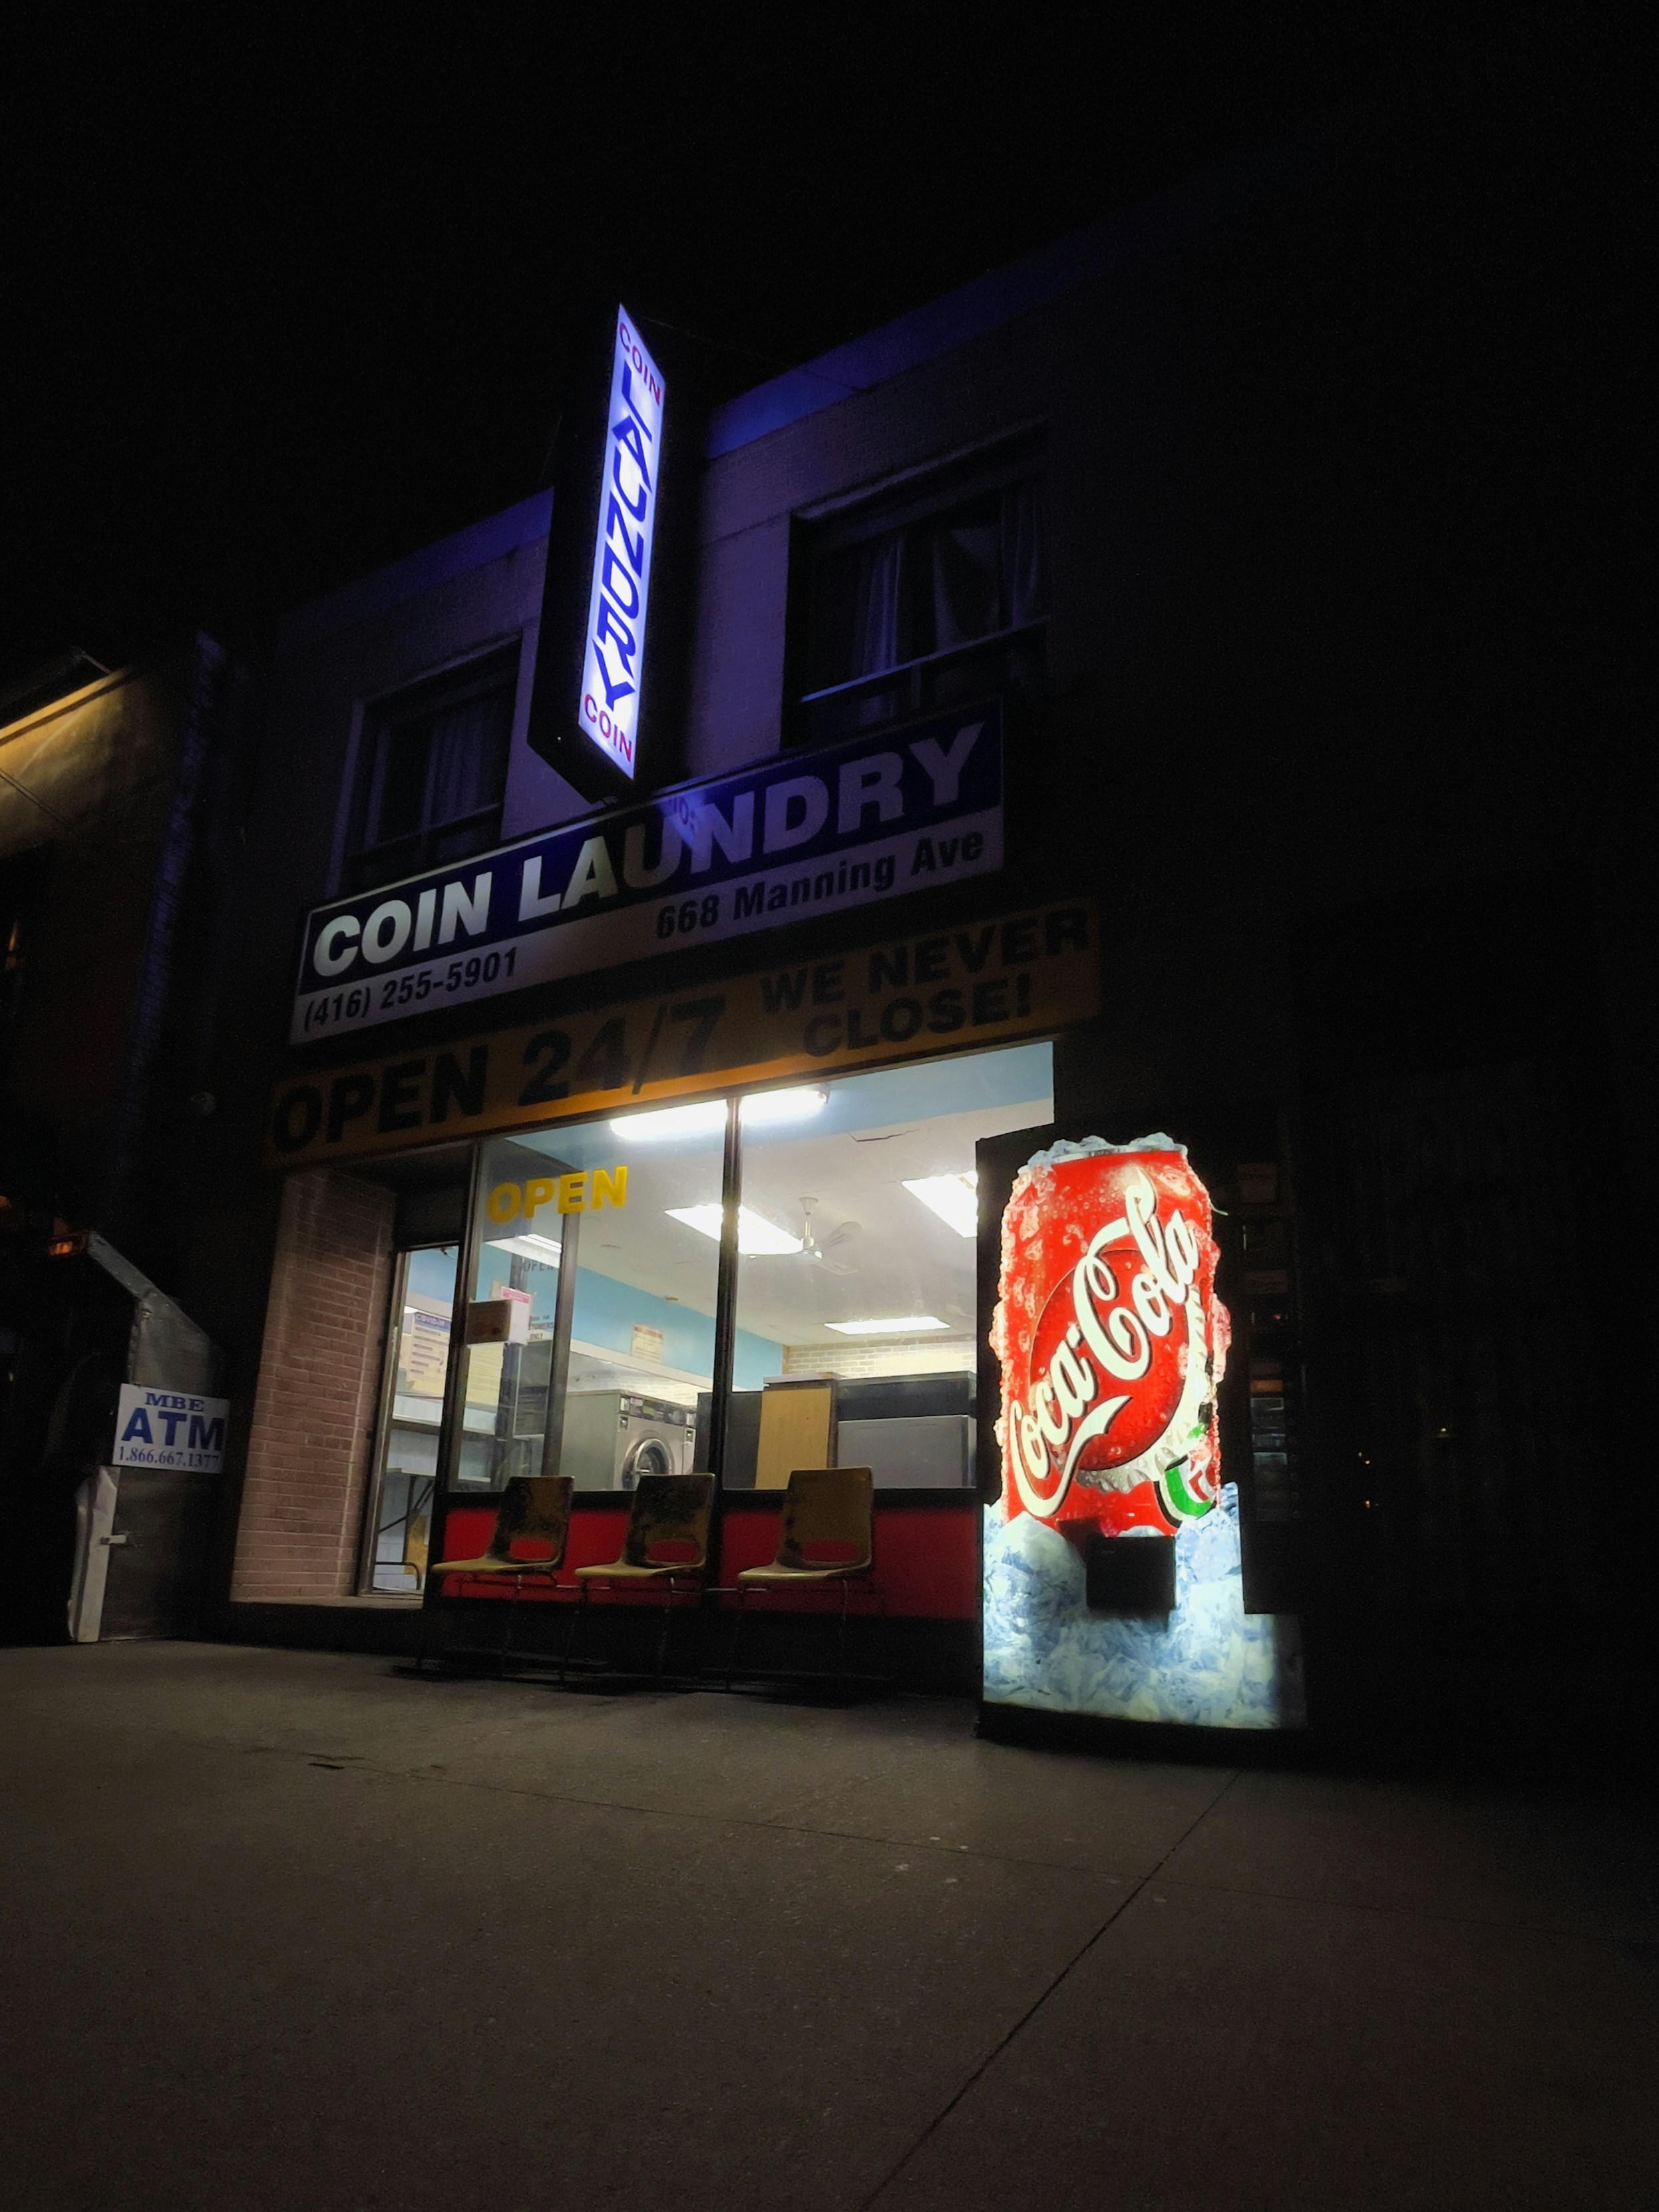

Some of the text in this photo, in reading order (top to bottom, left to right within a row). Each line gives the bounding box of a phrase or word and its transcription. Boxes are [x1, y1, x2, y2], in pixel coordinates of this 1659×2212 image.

[619, 322, 661, 405] COIN
[592, 359, 653, 710] LAUNDRY
[584, 694, 632, 762] COIN
[313, 721, 984, 976] COIN LAUNDRY
[657, 831, 983, 938] 668 Manning Ave
[304, 947, 516, 1030] (416) 255-5901
[761, 908, 1089, 1013] WE NEVER
[803, 974, 1031, 1057] CLOSE!
[274, 997, 727, 1152] OPEN 24/7
[486, 1166, 628, 1224] OPEN
[1010, 1168, 1199, 1518] Coca-Cola
[122, 1407, 224, 1451] ATM
[145, 1392, 204, 1412] MBE
